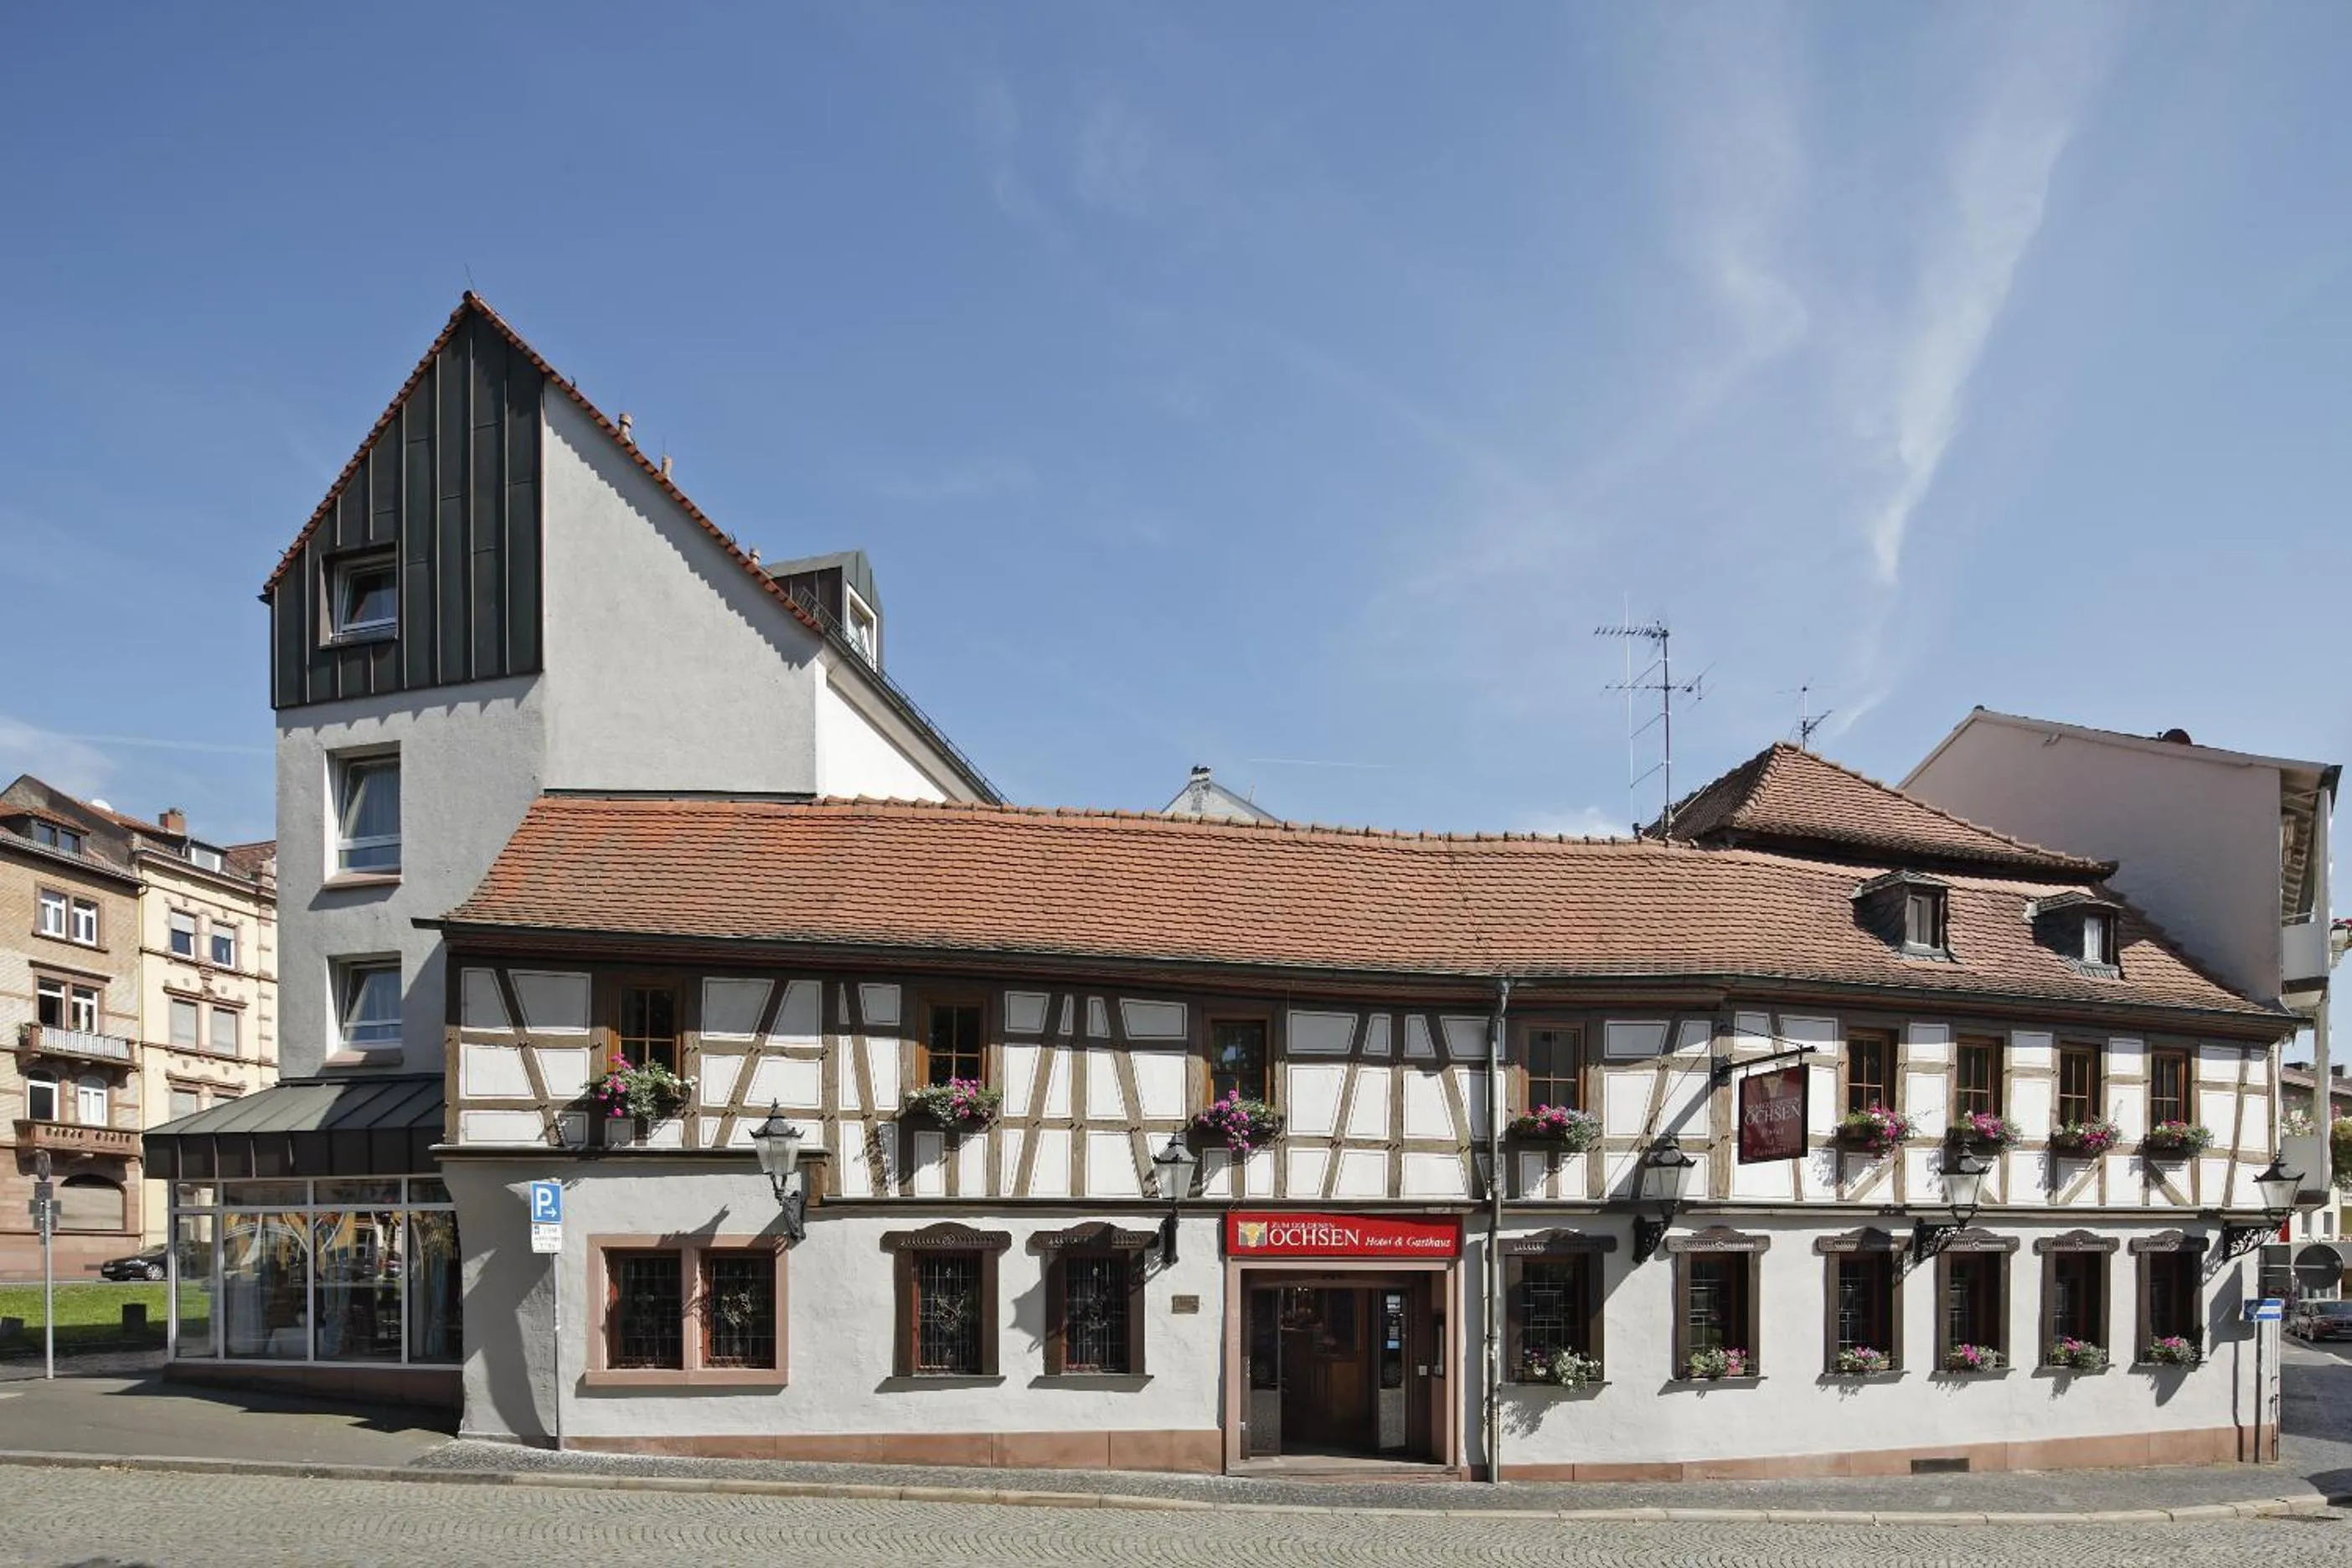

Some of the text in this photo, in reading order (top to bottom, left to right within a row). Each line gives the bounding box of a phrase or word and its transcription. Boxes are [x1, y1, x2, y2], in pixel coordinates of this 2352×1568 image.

[1745, 1103, 1802, 1126] OCHSEN
[536, 1188, 553, 1217] P
[1270, 1228, 1452, 1247] OCHSEN Hotel & Gasthaus
